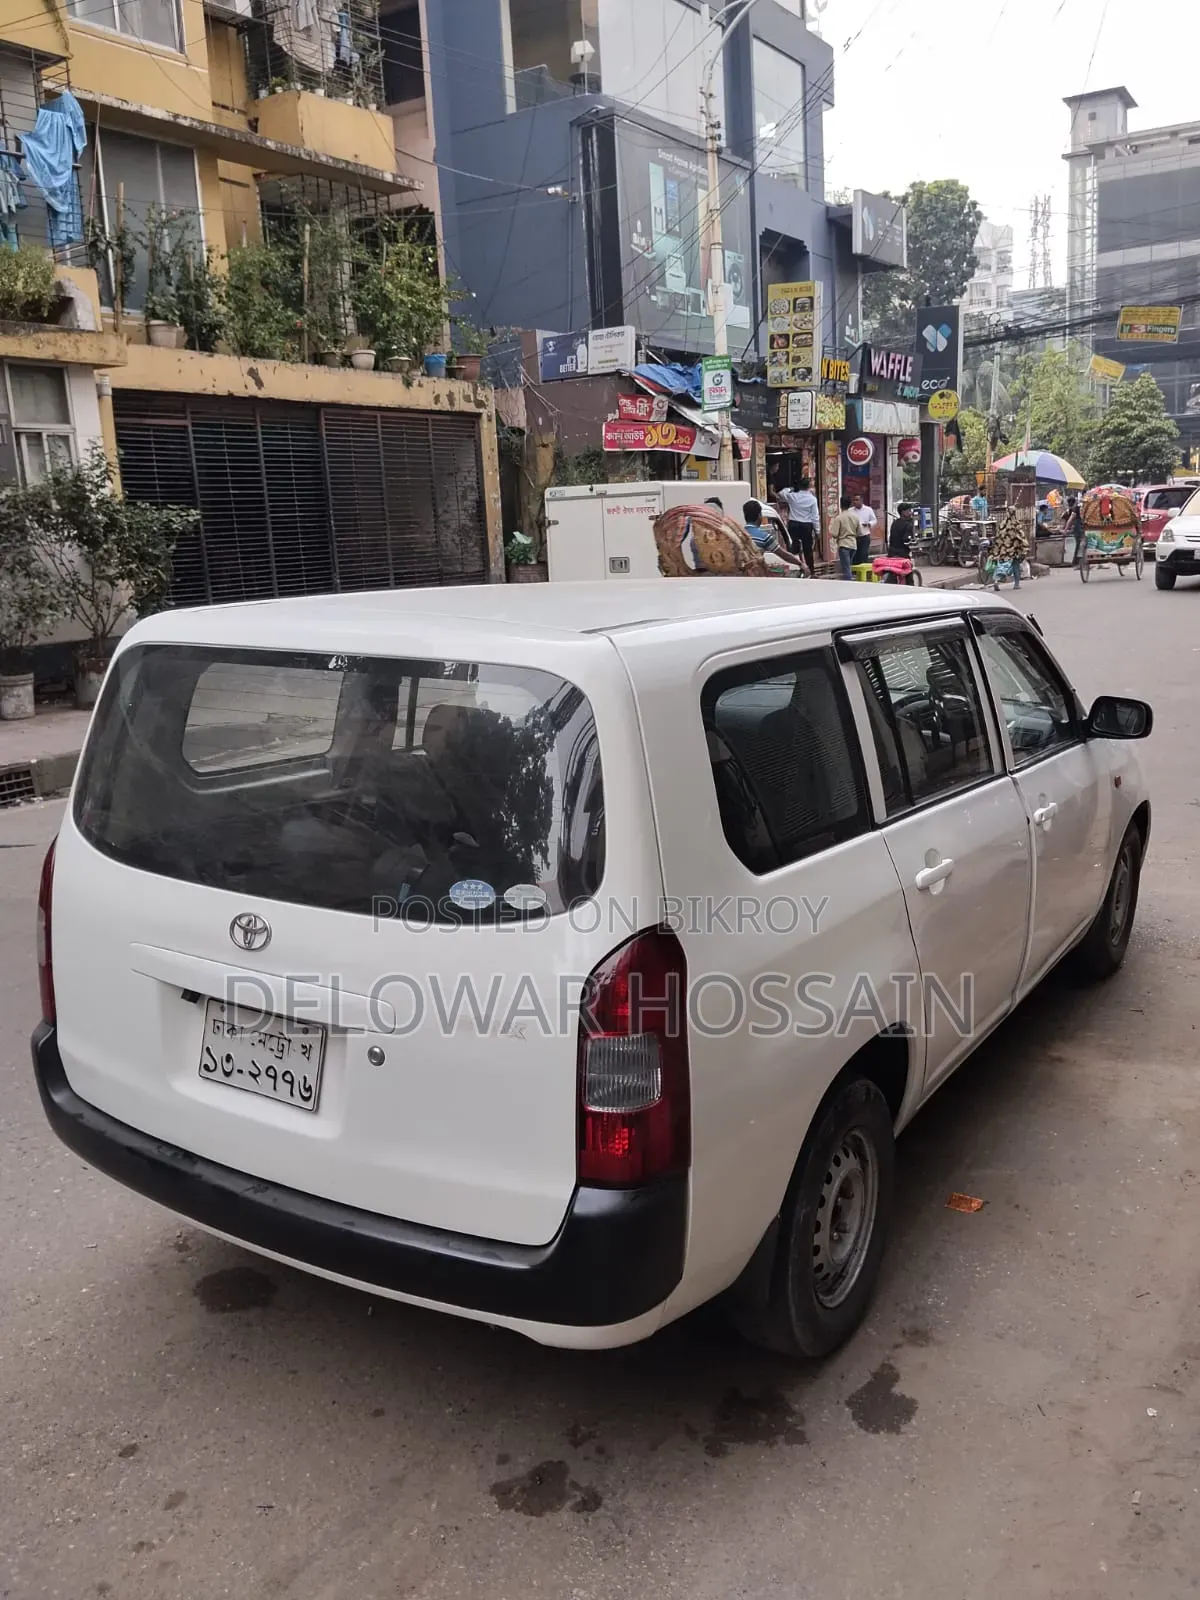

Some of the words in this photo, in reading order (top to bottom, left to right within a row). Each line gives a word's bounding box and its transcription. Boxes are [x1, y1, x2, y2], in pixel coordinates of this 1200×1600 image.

[1147, 325, 1175, 334] Fingers
[559, 363, 577, 373] BETTER
[828, 360, 850, 382] BITES
[870, 347, 914, 383] WAFFLE
